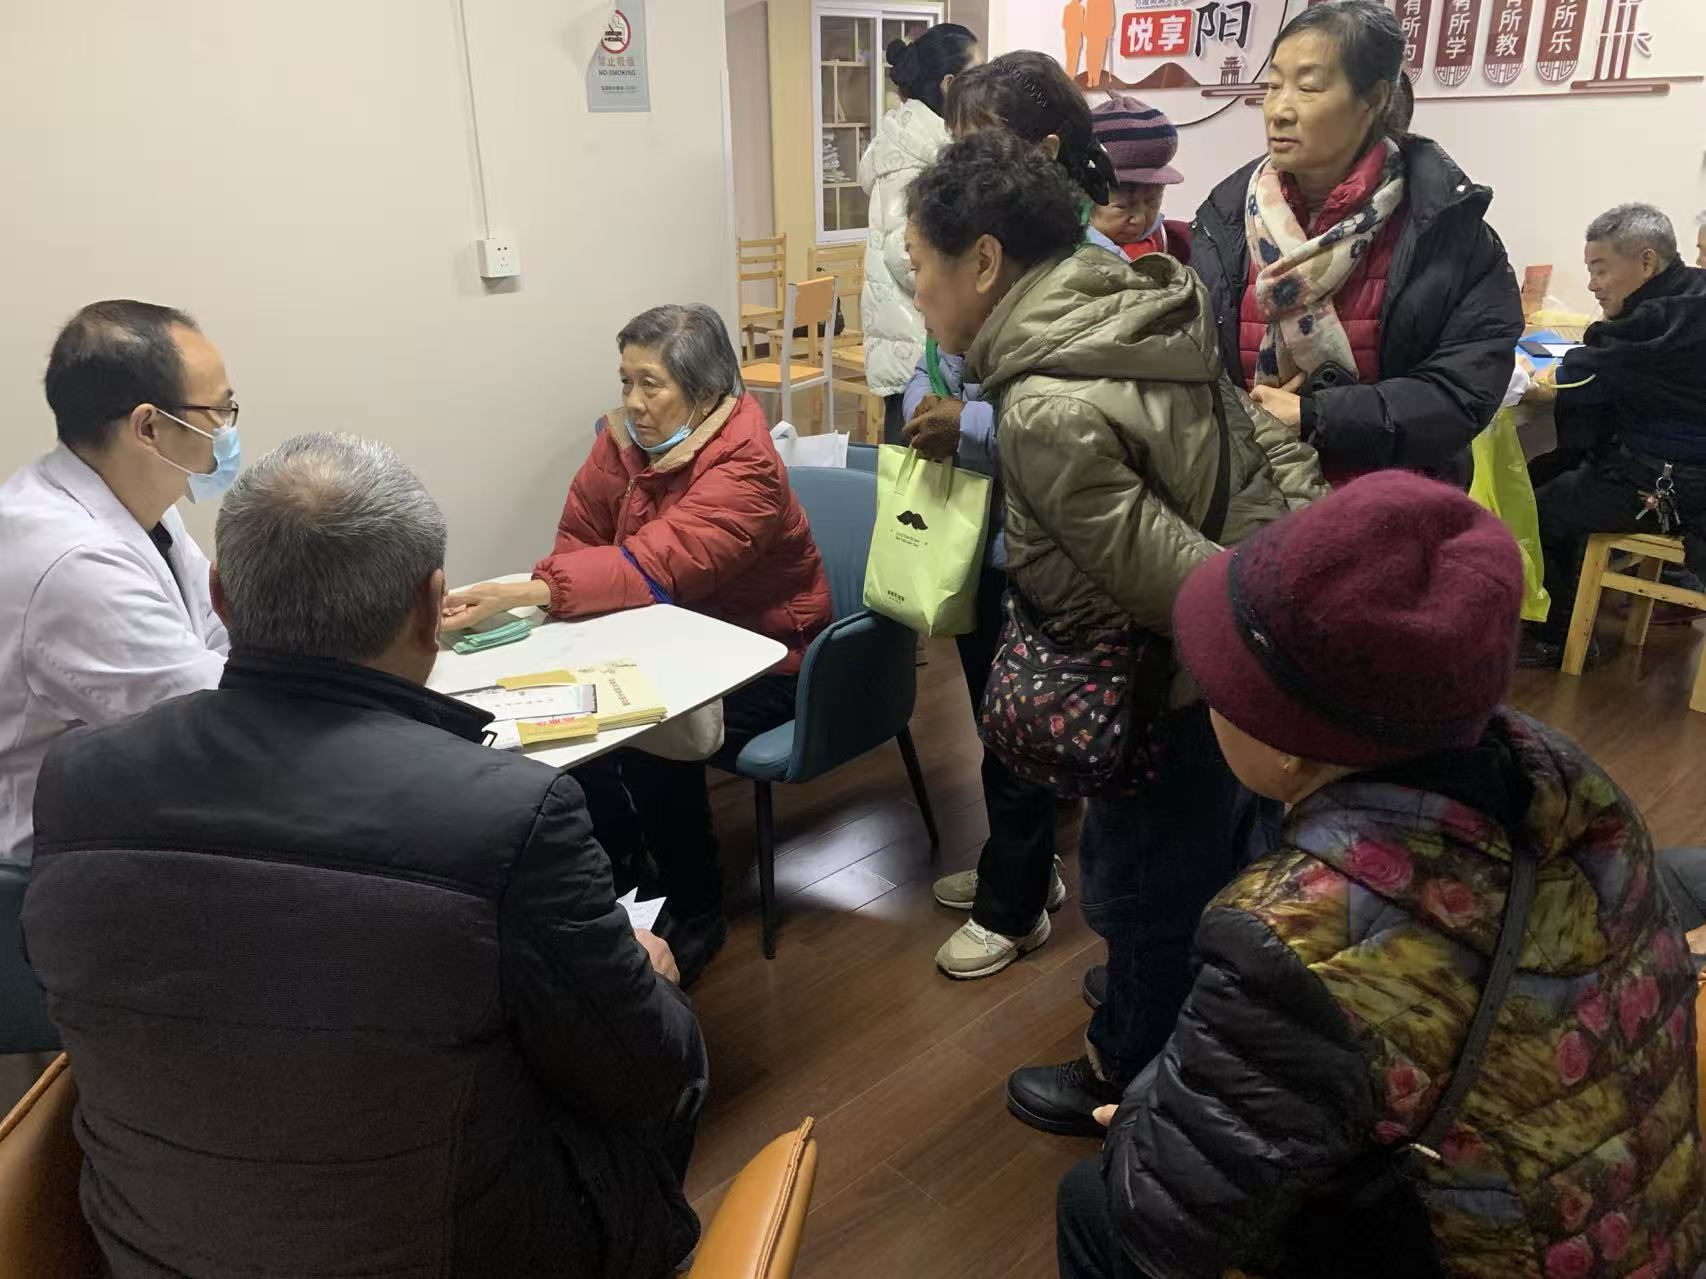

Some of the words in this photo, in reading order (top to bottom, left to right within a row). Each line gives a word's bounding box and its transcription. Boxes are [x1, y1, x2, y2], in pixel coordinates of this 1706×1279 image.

[1127, 15, 1186, 53] 悦享
[1195, 0, 1252, 57] 阳
[1548, 0, 1577, 54] 所乐
